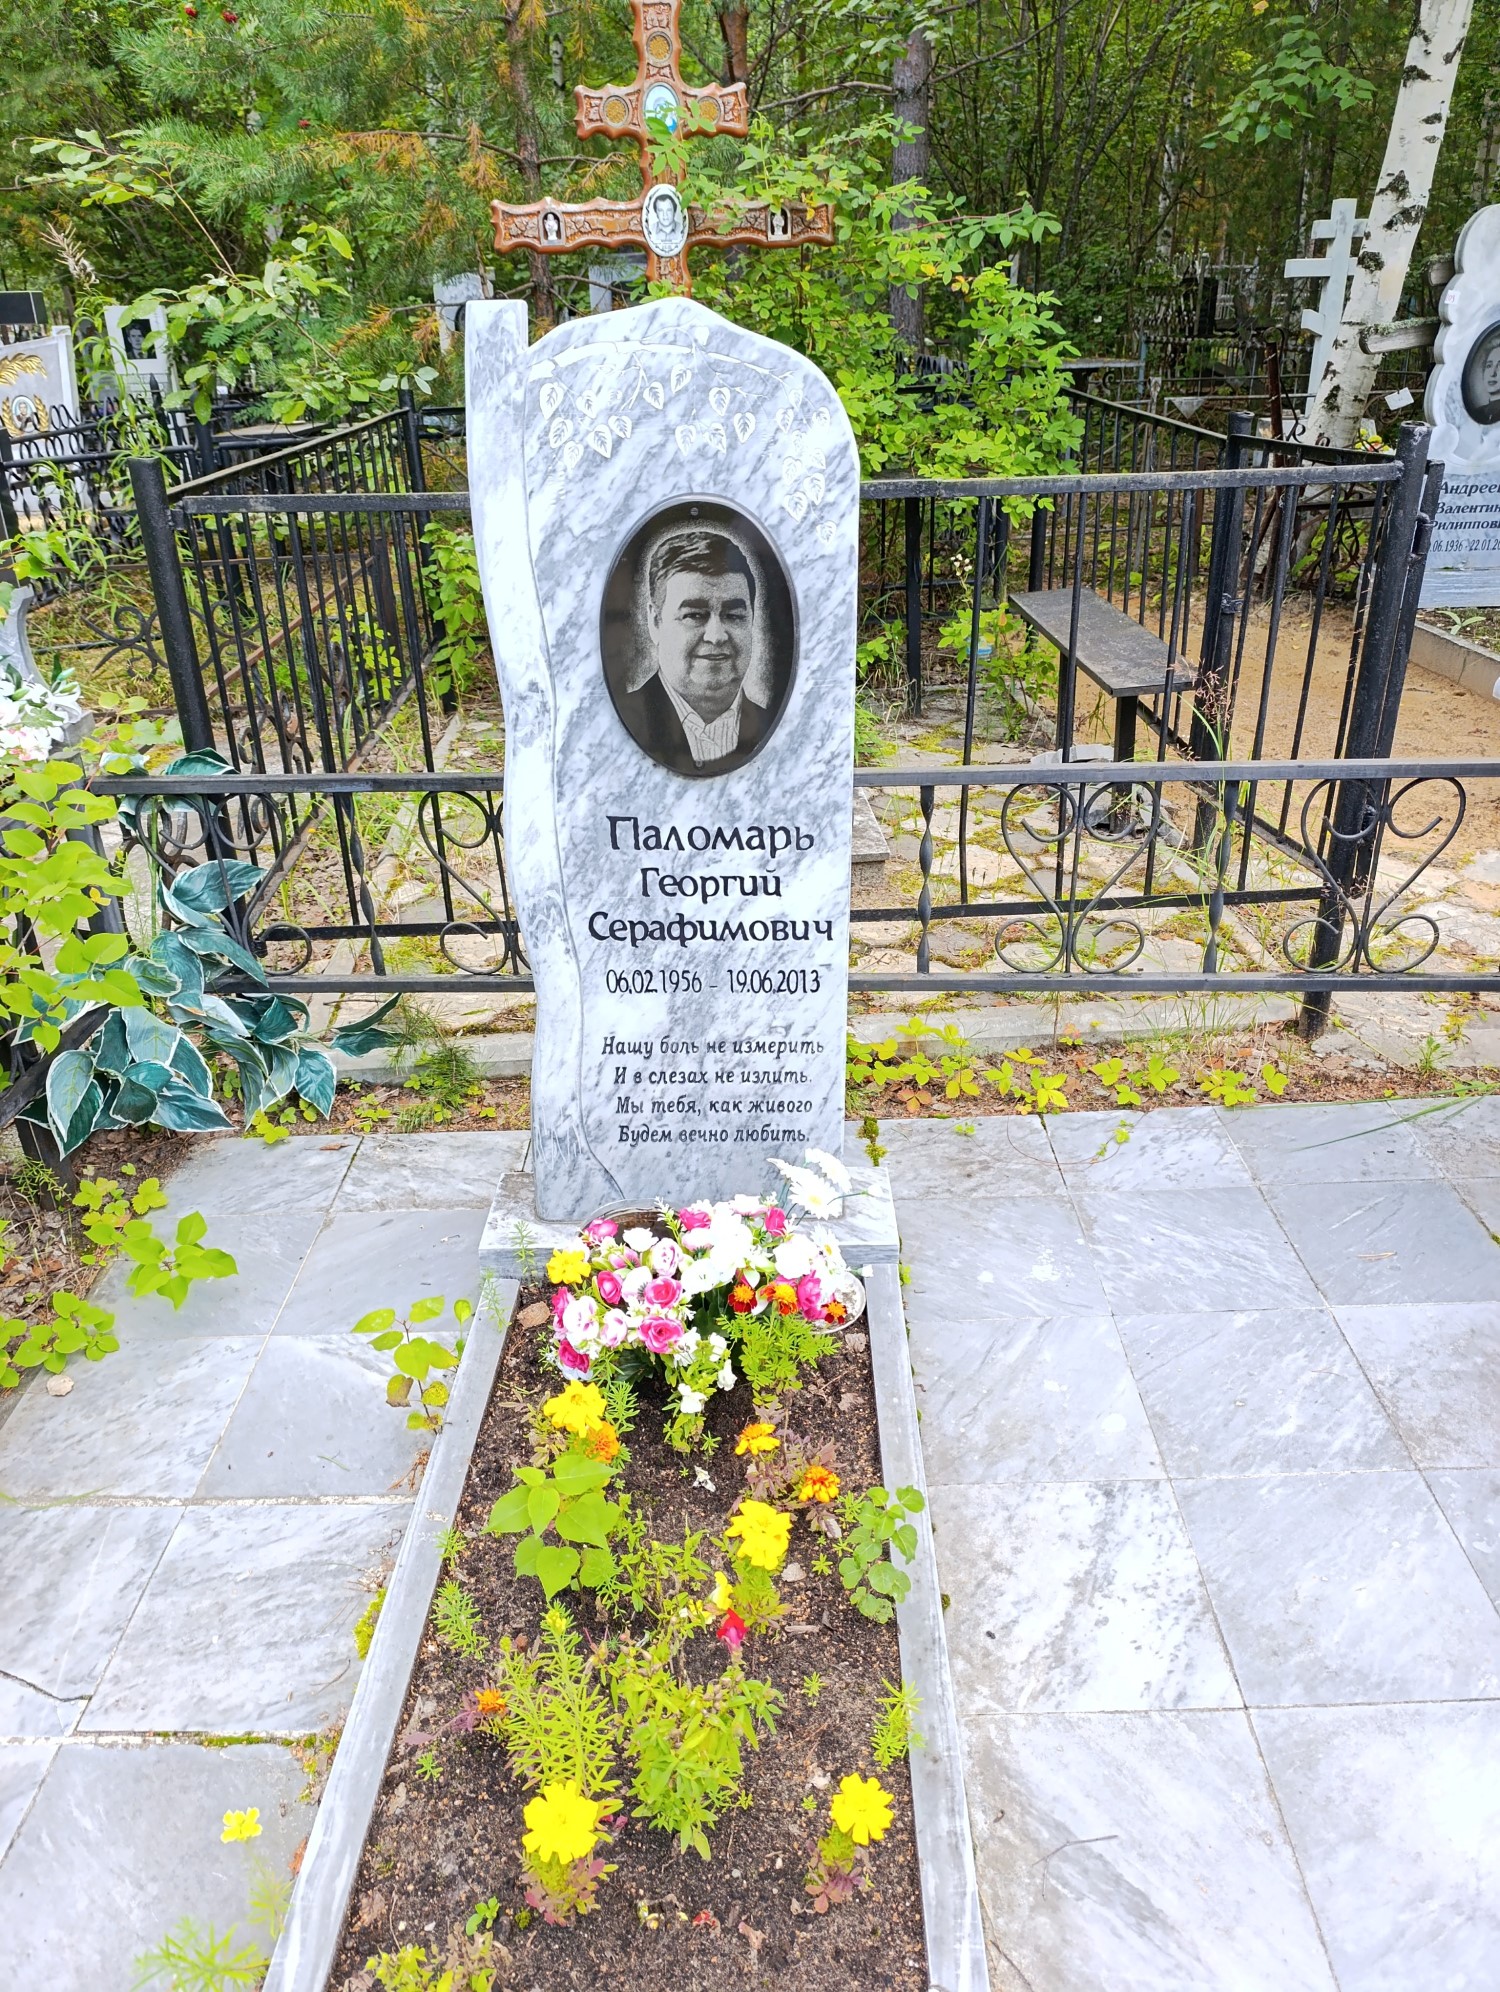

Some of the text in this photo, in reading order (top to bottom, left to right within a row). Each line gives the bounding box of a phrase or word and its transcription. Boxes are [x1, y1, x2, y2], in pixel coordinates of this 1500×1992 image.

[606, 815, 815, 859] Паломарь
[640, 867, 782, 904] Георгий
[588, 911, 833, 948] Серафимович
[606, 969, 702, 994] 06.02.1956
[727, 969, 821, 994] 19.06.2013
[601, 1035, 825, 1060] Нашу боль не измерить
[614, 1066, 813, 1085] И в слезах не излить.
[615, 1094, 813, 1117] Мы тебя, как живого
[618, 1123, 811, 1147] Будем вечно любить.
